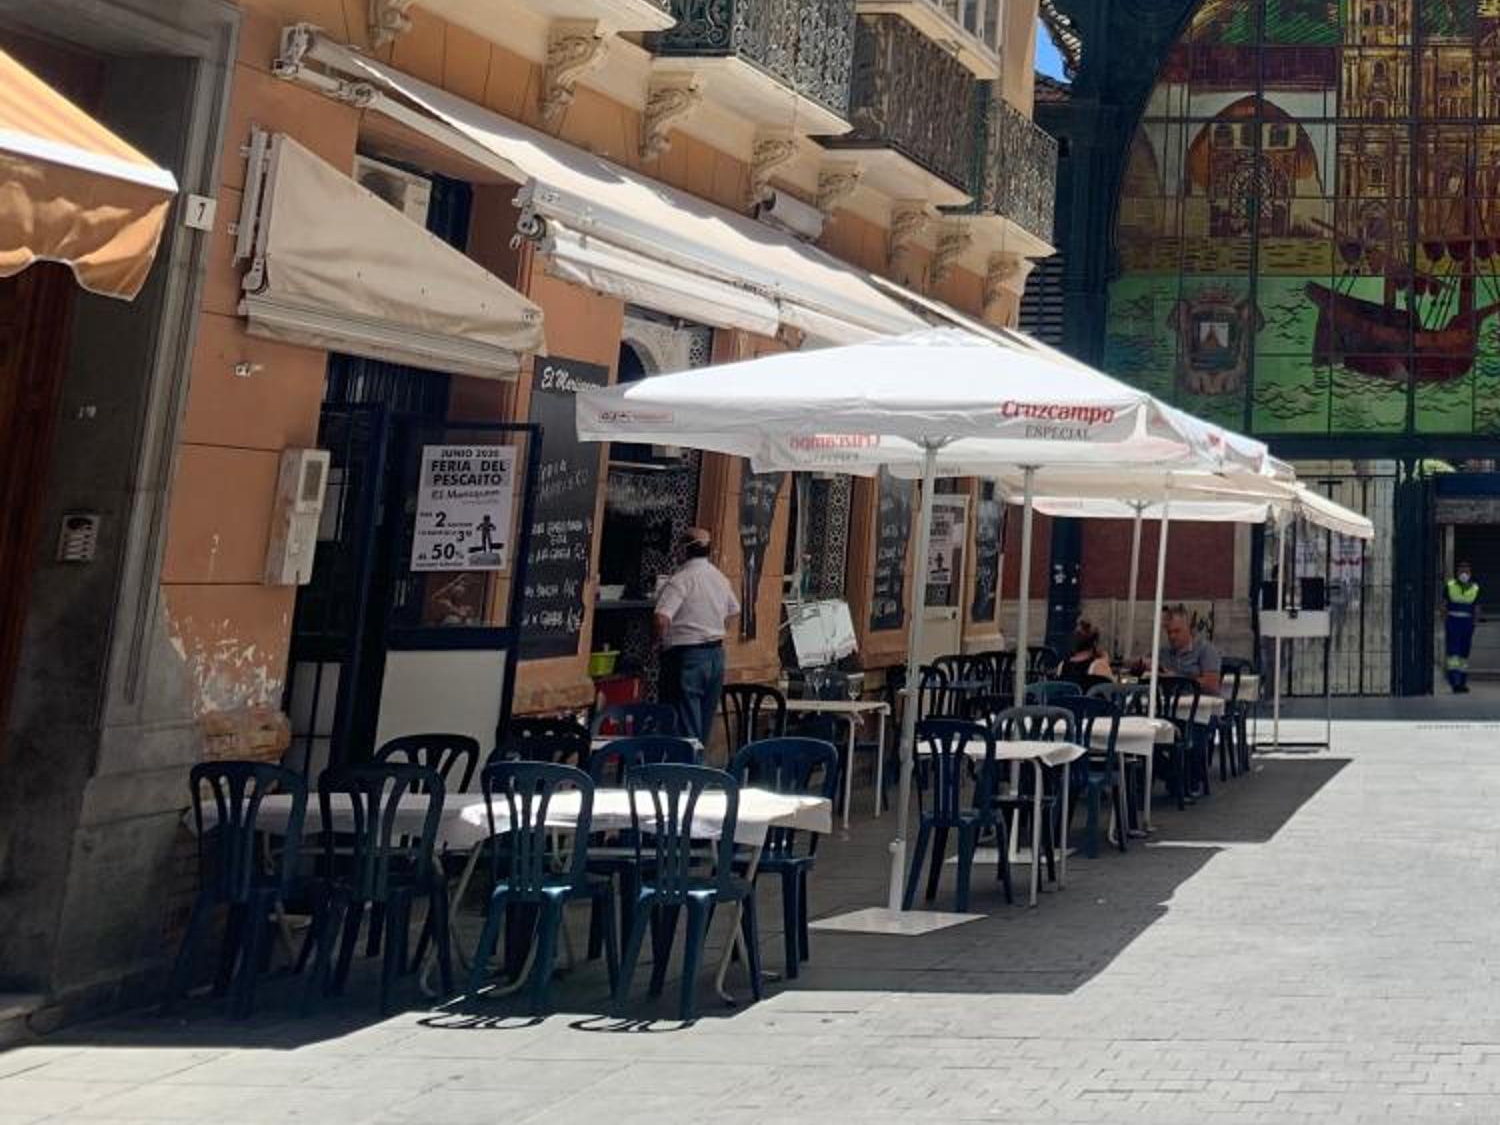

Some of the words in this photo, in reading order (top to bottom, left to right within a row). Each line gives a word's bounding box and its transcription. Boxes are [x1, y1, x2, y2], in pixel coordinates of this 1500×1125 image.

[1001, 400, 1117, 424] Cruzcampo
[1025, 426, 1090, 441] ESPECIAL
[441, 449, 472, 458] JUNIO
[431, 460, 471, 472] FERIA
[481, 460, 507, 472] DEL
[433, 474, 502, 486] PESCAITO
[435, 511, 446, 527] 2
